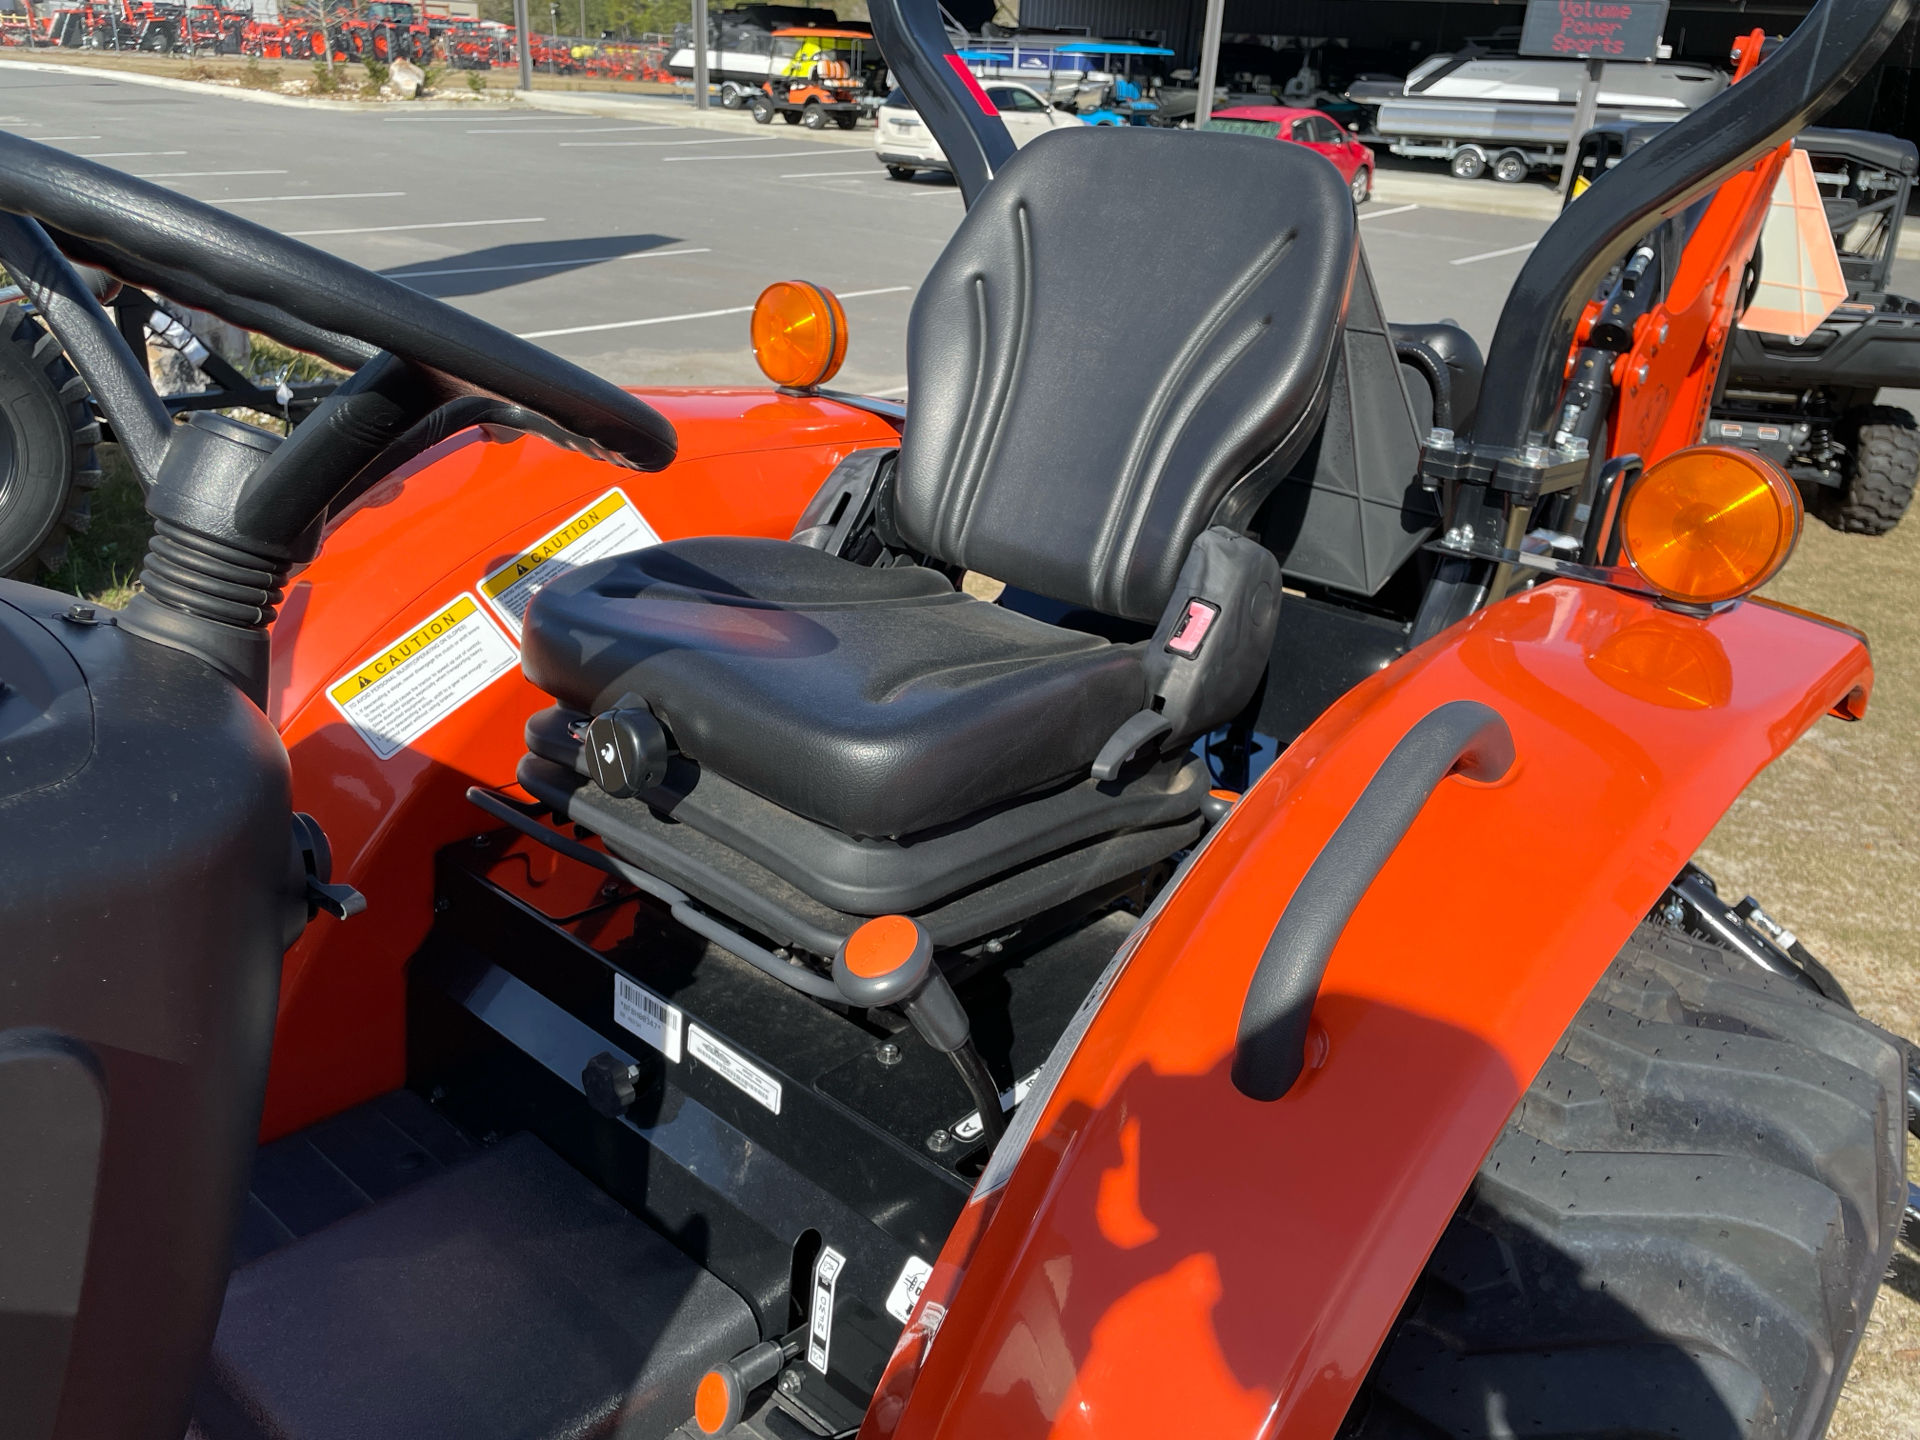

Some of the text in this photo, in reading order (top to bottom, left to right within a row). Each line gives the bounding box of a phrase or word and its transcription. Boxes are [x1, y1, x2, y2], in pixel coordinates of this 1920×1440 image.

[1558, 0, 1633, 19] Volume
[1560, 16, 1622, 36] Power
[1552, 34, 1625, 54] Sports
[529, 510, 600, 564] CAUTION
[372, 612, 456, 675] CAUTION
